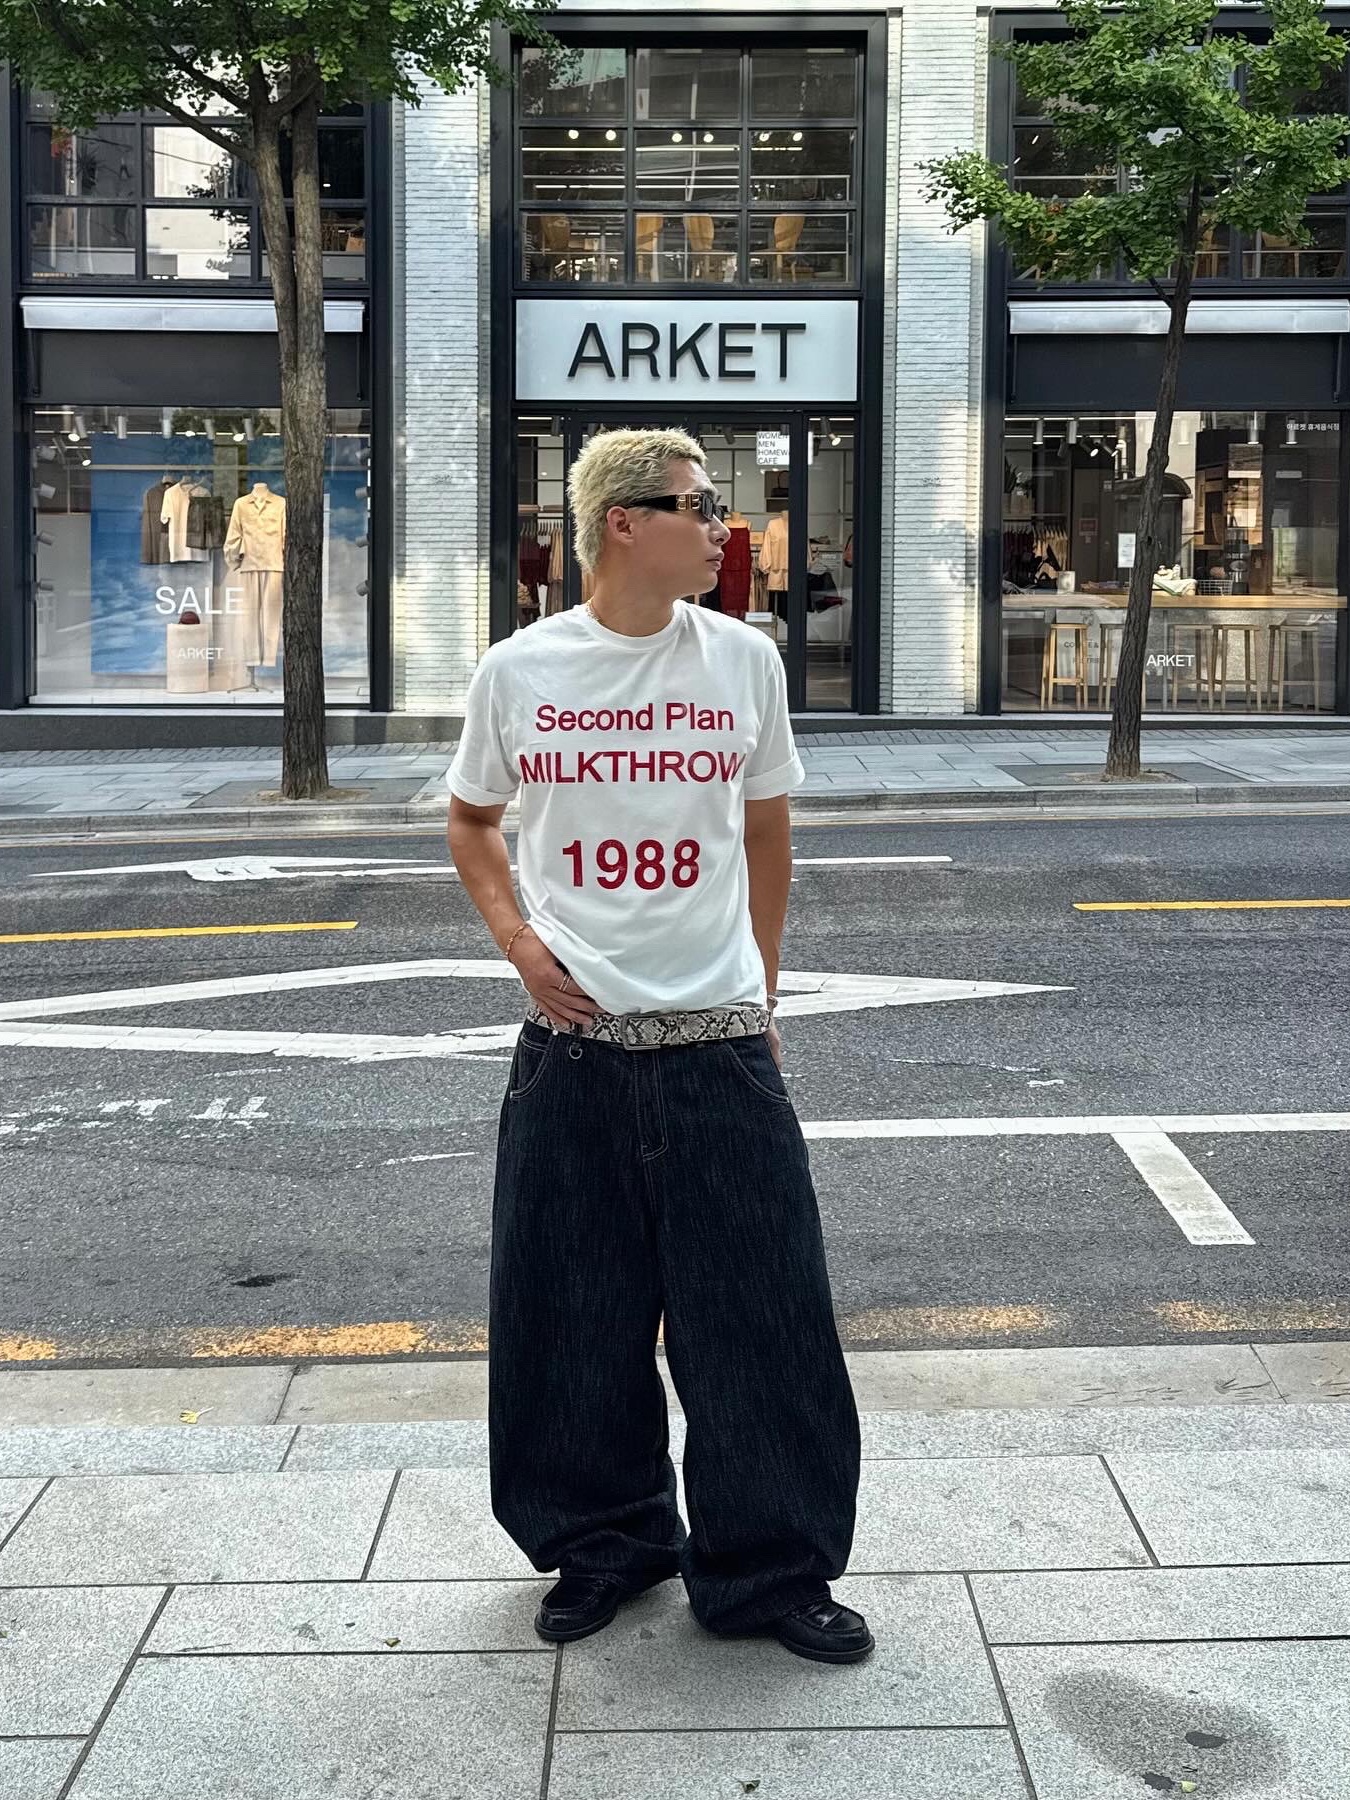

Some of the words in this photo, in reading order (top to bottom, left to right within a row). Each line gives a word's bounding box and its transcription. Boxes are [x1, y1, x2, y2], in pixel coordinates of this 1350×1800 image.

[567, 322, 807, 378] ARKET
[758, 440, 776, 448] MEN
[155, 585, 245, 616] SALE
[178, 646, 224, 660] ARKET
[1146, 654, 1196, 667] ARKET
[535, 702, 654, 732] Second
[665, 702, 734, 731] Plan
[518, 750, 747, 784] MILKTHROW
[562, 838, 700, 890] 1988
